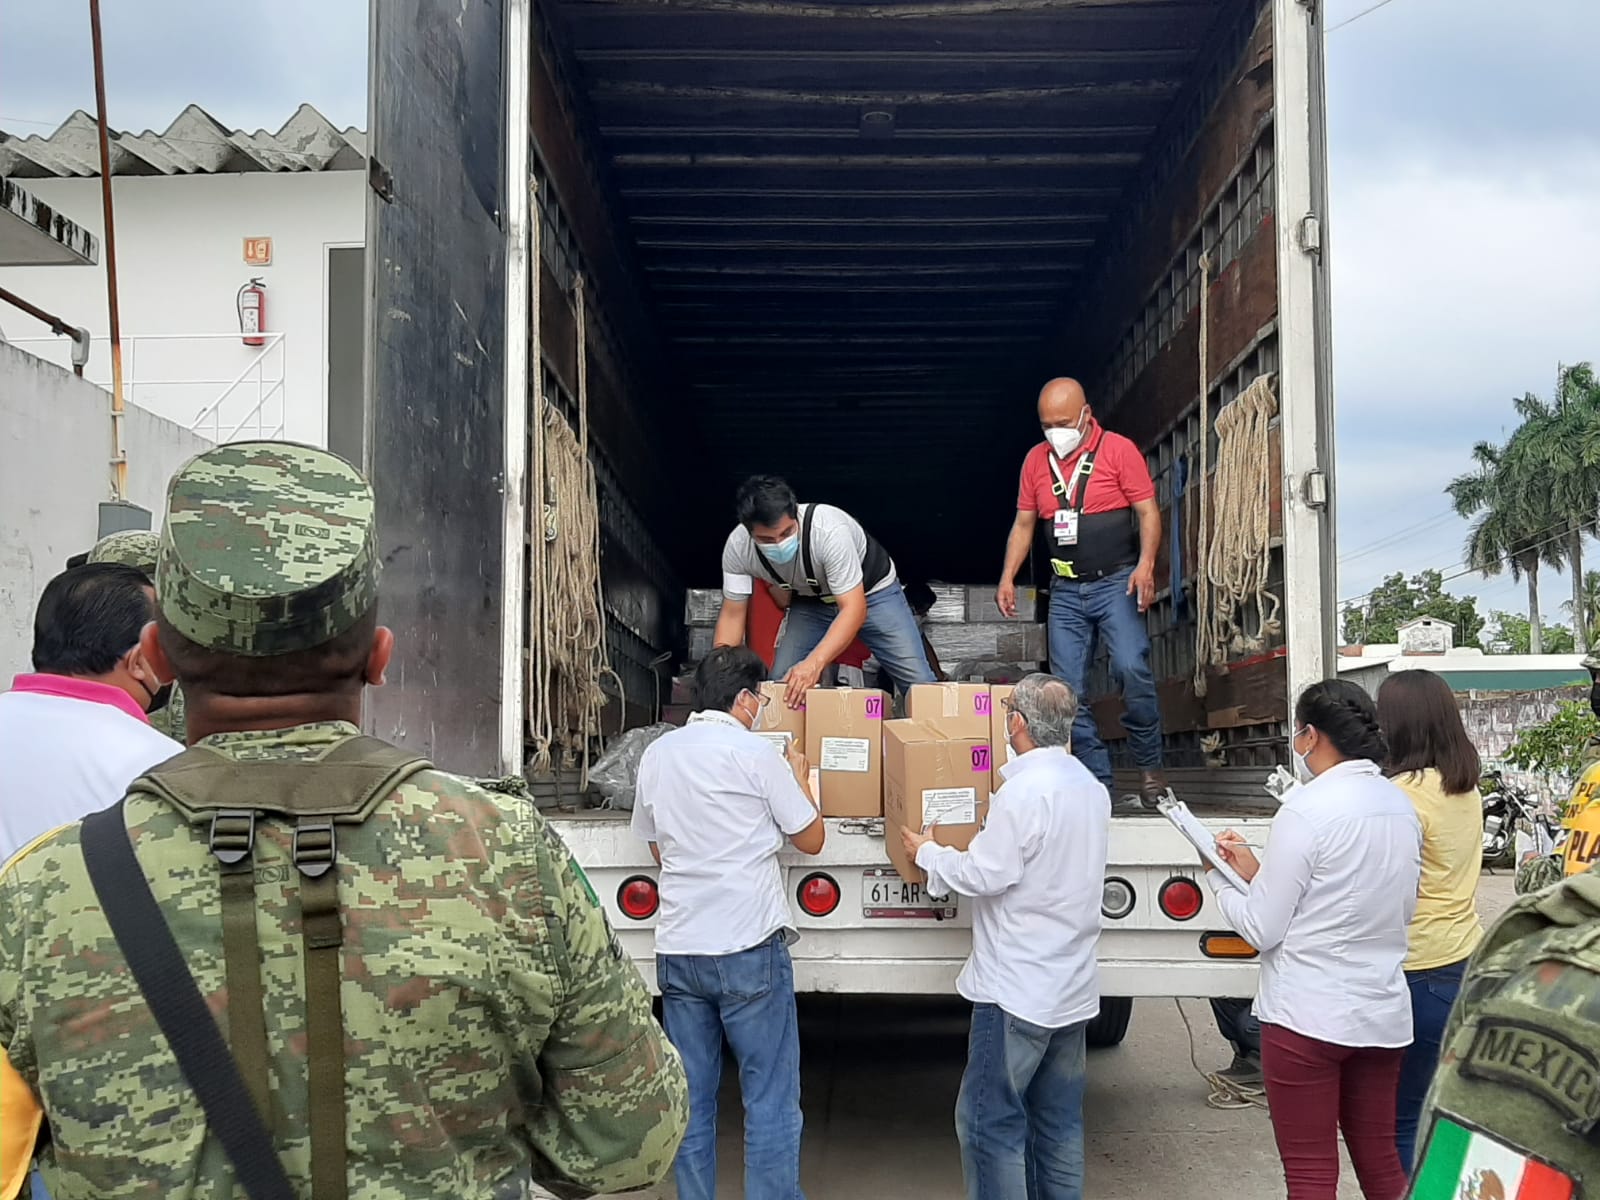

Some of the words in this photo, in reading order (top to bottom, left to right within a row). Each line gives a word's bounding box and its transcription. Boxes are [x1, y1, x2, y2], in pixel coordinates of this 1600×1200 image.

[865, 698, 880, 714] 07
[974, 695, 989, 711] 07
[971, 749, 988, 767] 07
